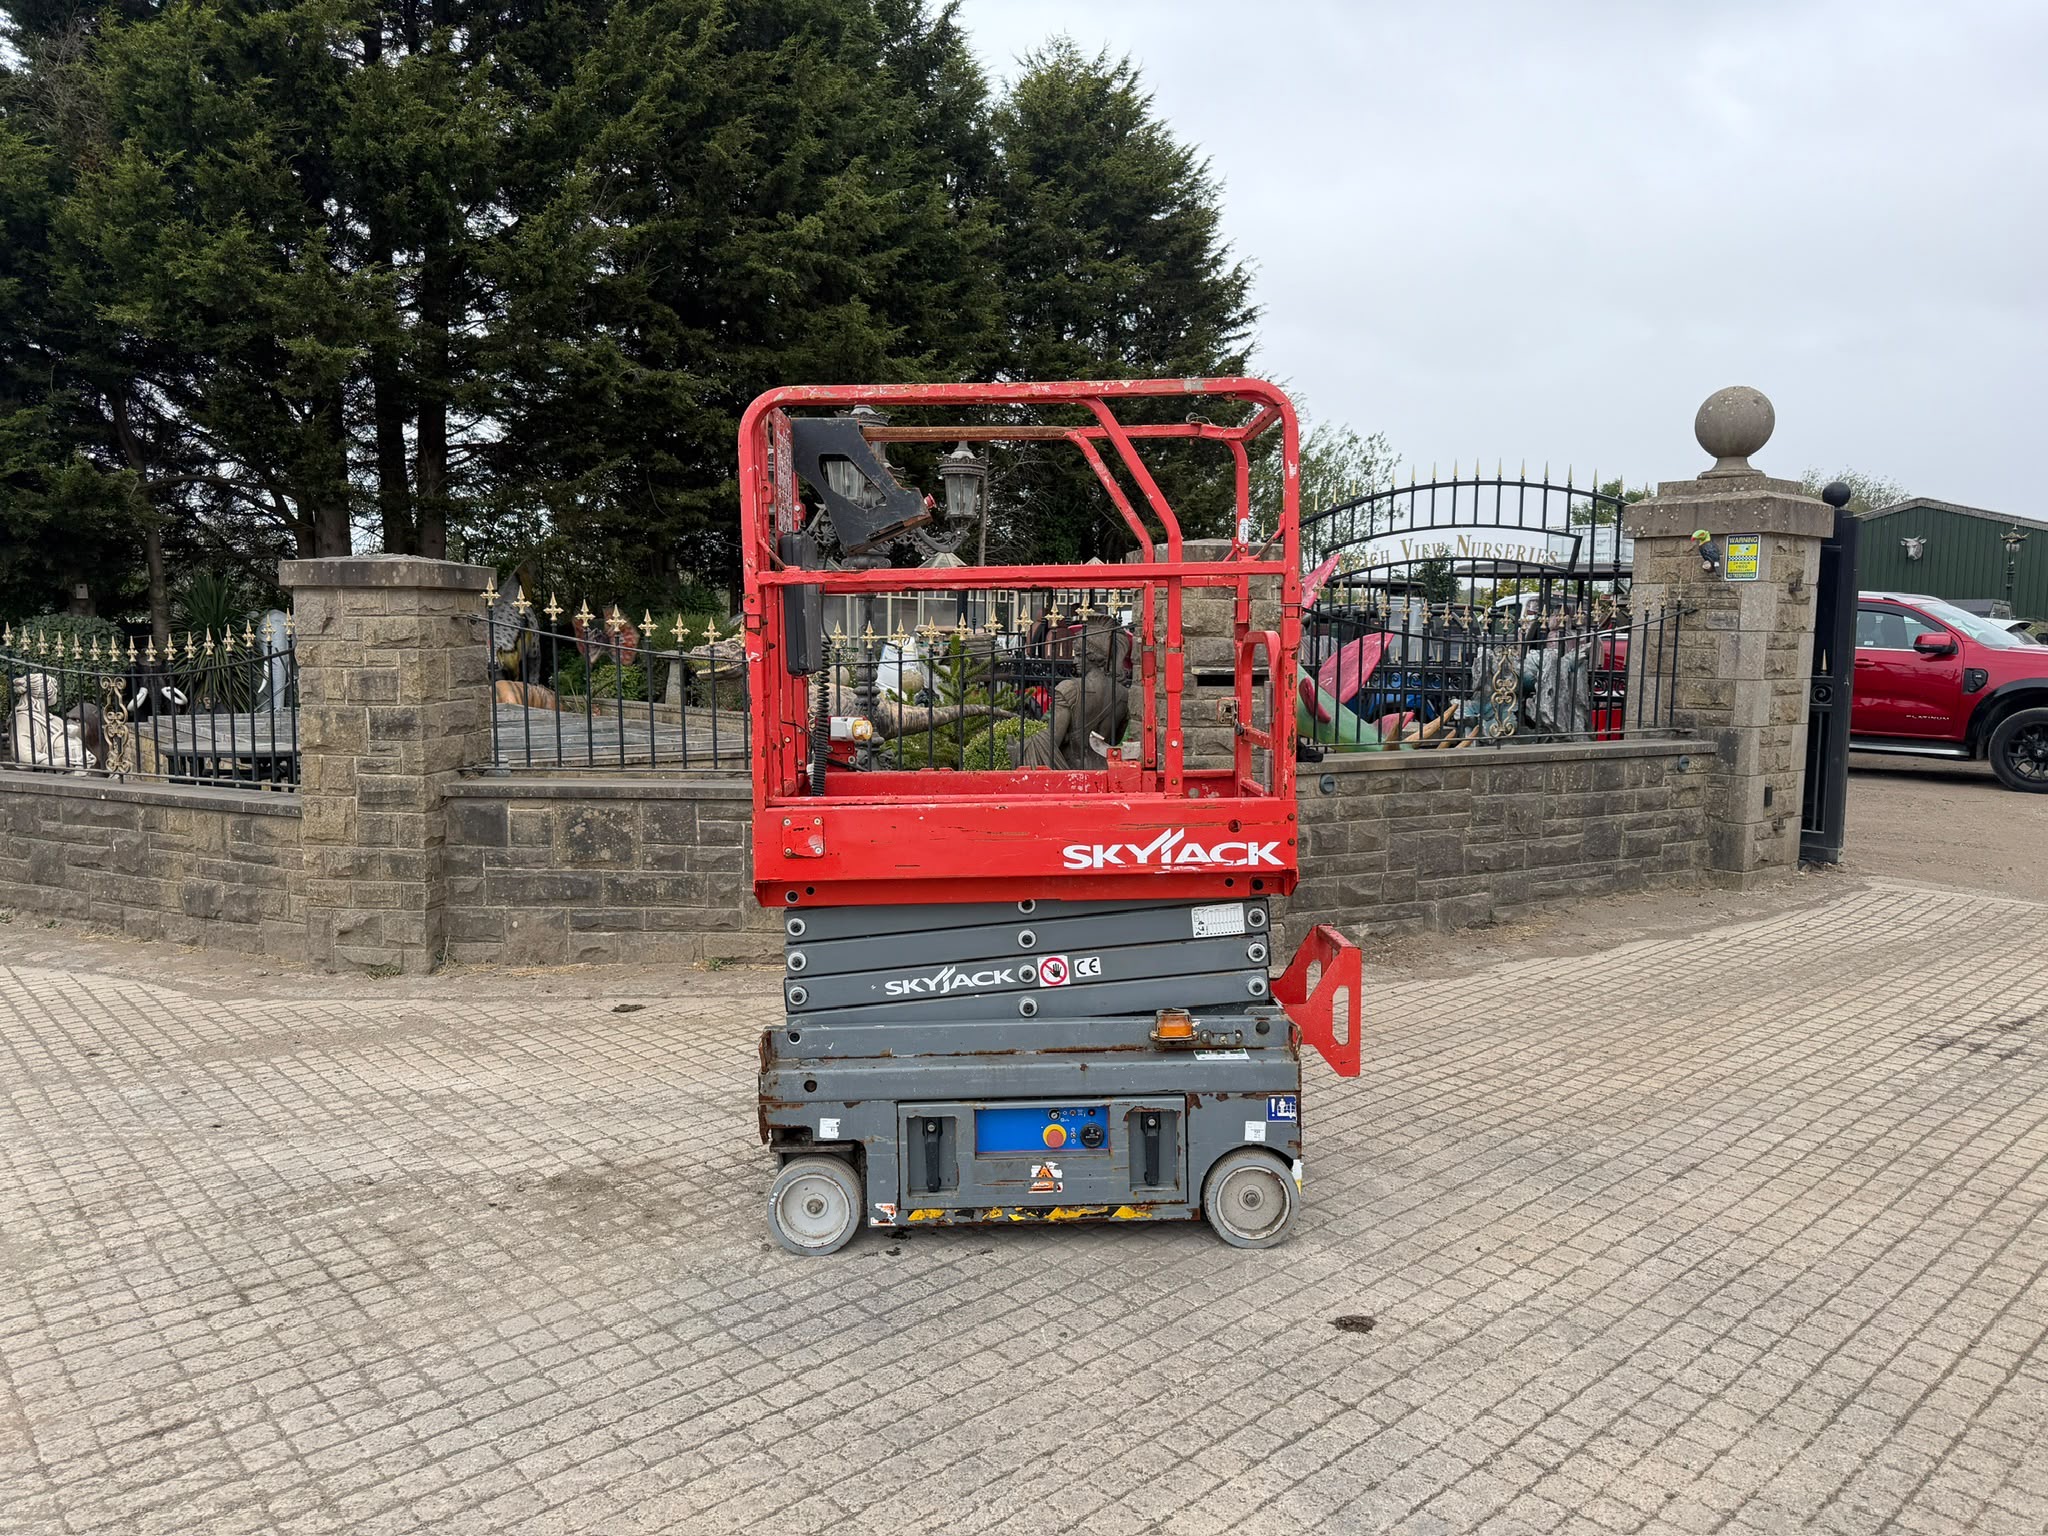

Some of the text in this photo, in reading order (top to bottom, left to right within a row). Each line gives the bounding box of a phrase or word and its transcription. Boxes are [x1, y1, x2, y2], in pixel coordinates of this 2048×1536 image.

[1400, 538, 1446, 560] VIEW
[1456, 535, 1558, 566] NURSERIES
[1062, 827, 1285, 874] SKYJACK
[884, 965, 1017, 996] SKYJACK
[1076, 958, 1099, 976] CE
